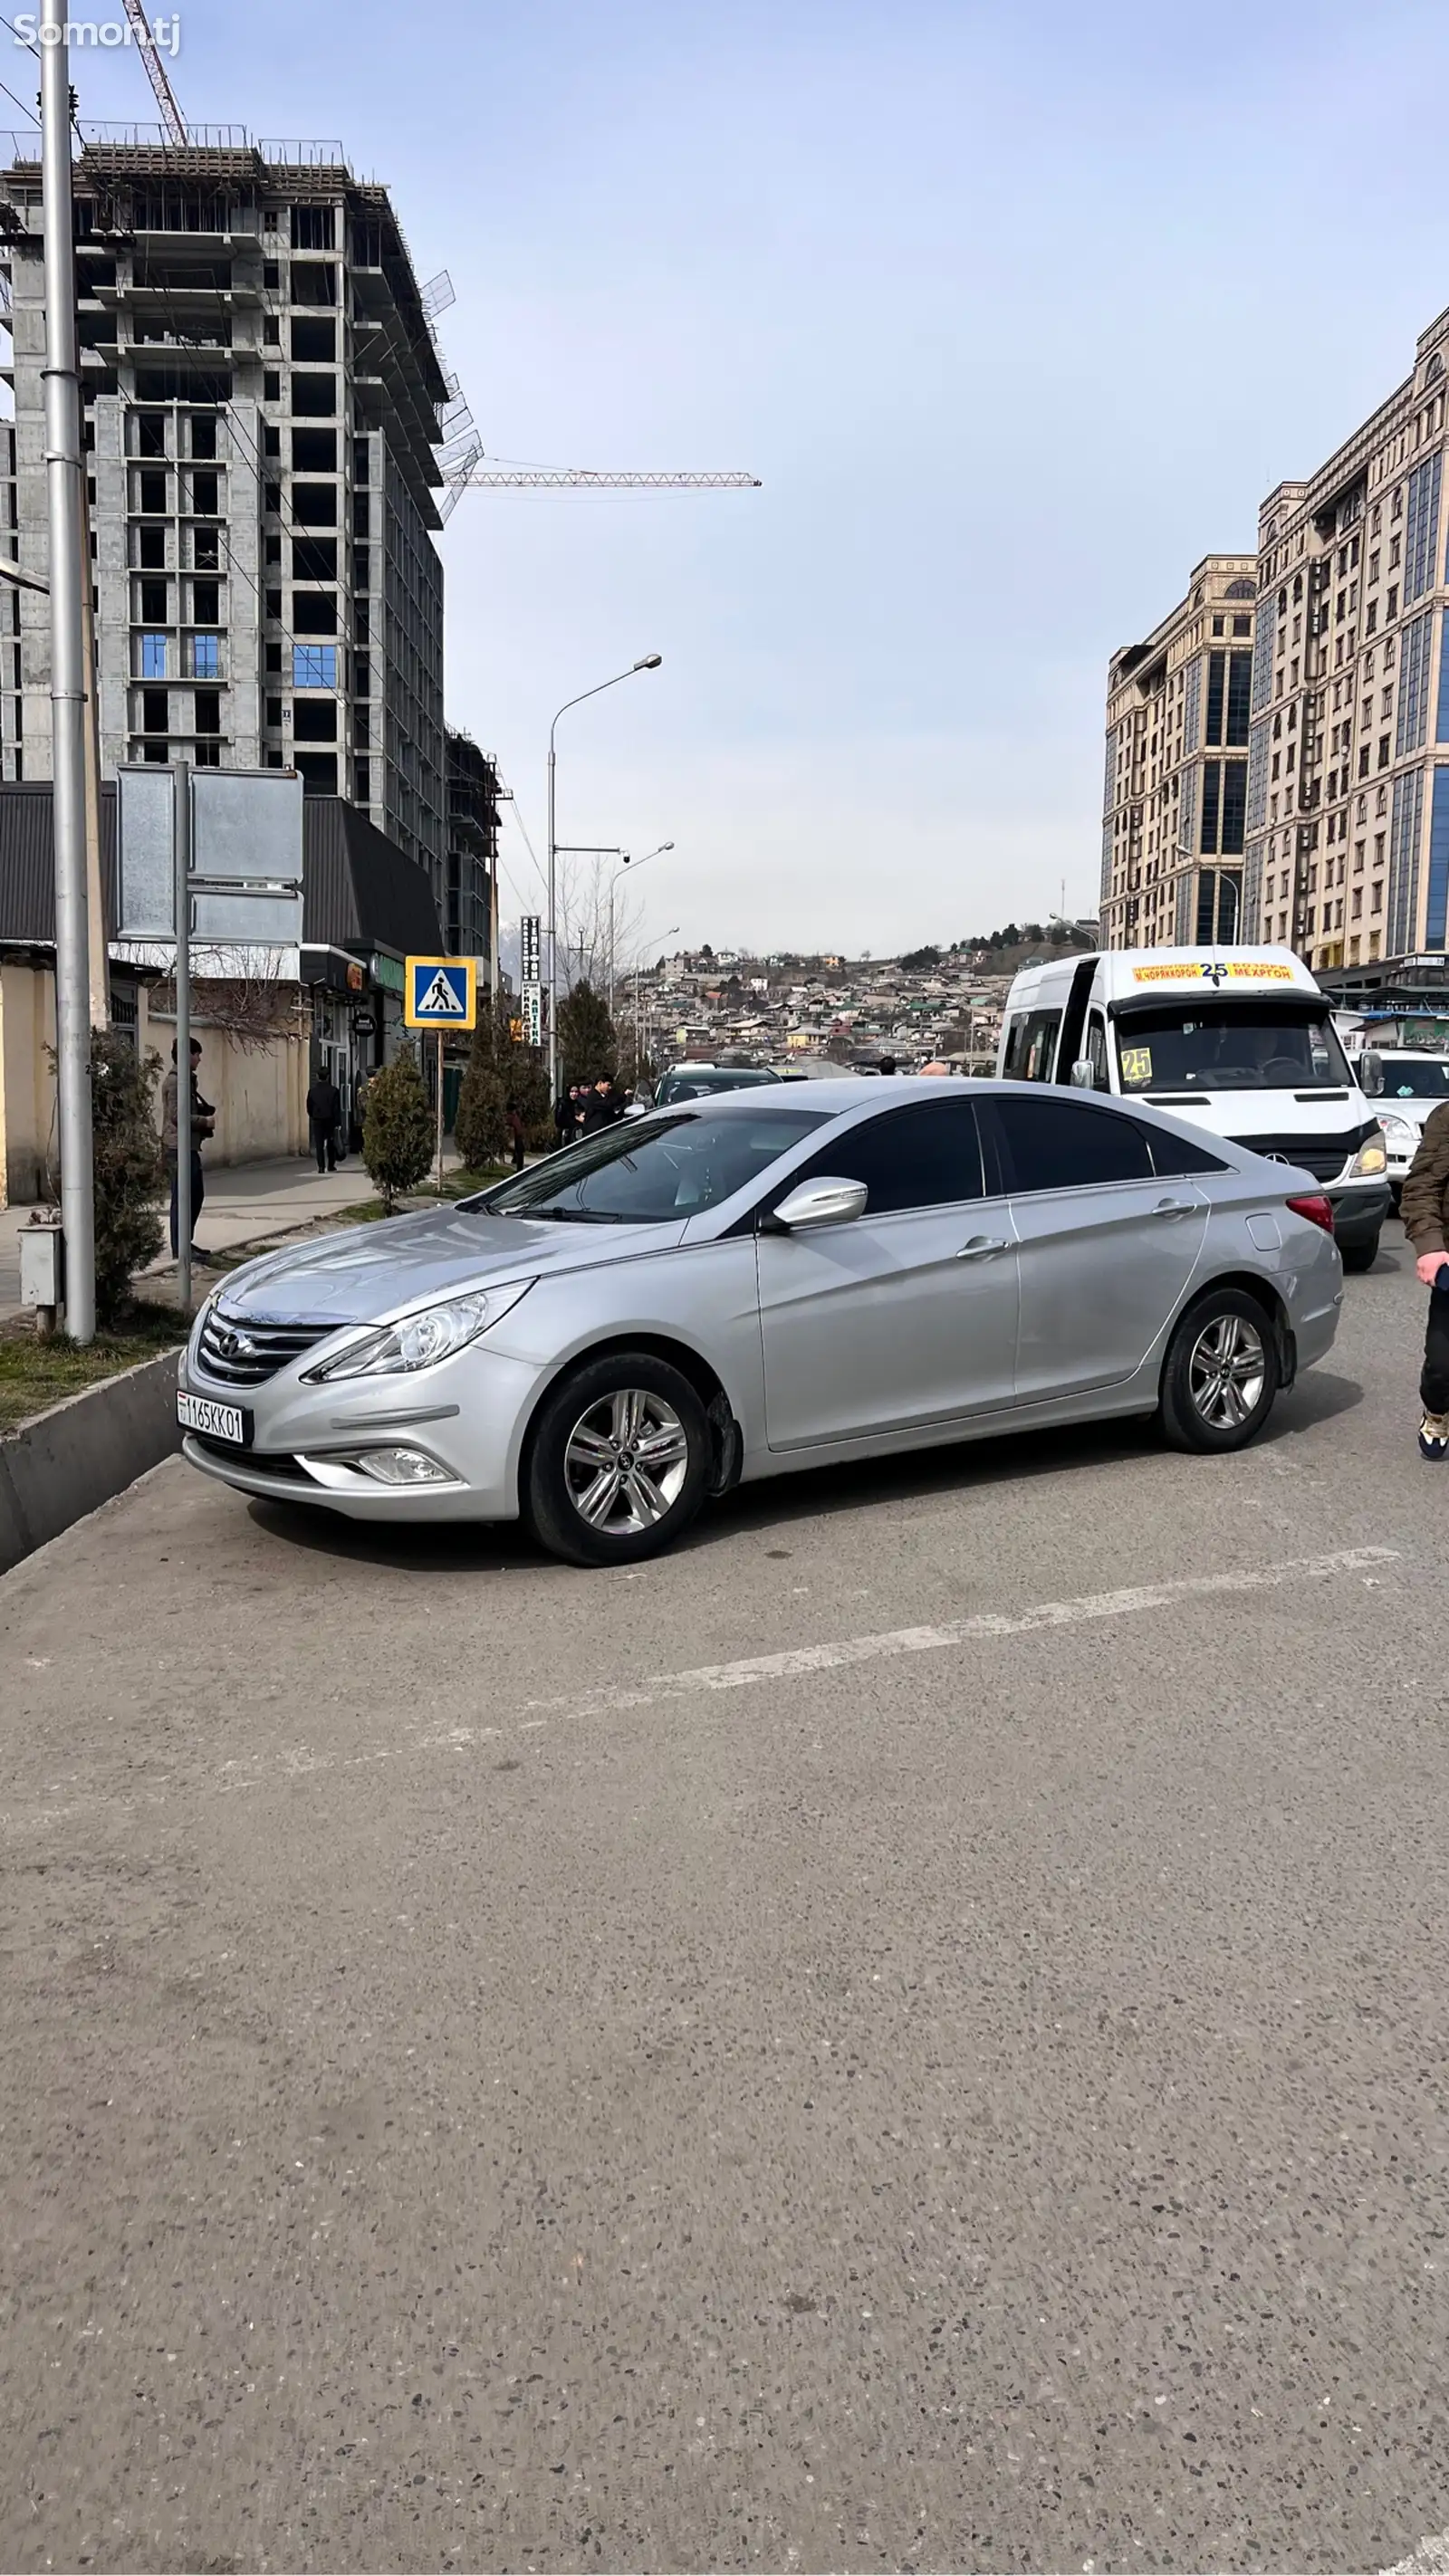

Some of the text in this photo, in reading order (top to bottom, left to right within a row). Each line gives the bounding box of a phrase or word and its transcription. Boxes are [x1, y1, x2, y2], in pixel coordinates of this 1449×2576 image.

[530, 918, 540, 980] ТЕЛЕФОН
[1200, 963, 1228, 977] 25
[1123, 1050, 1150, 1077] 25
[187, 1398, 241, 1441] 1165KK01
